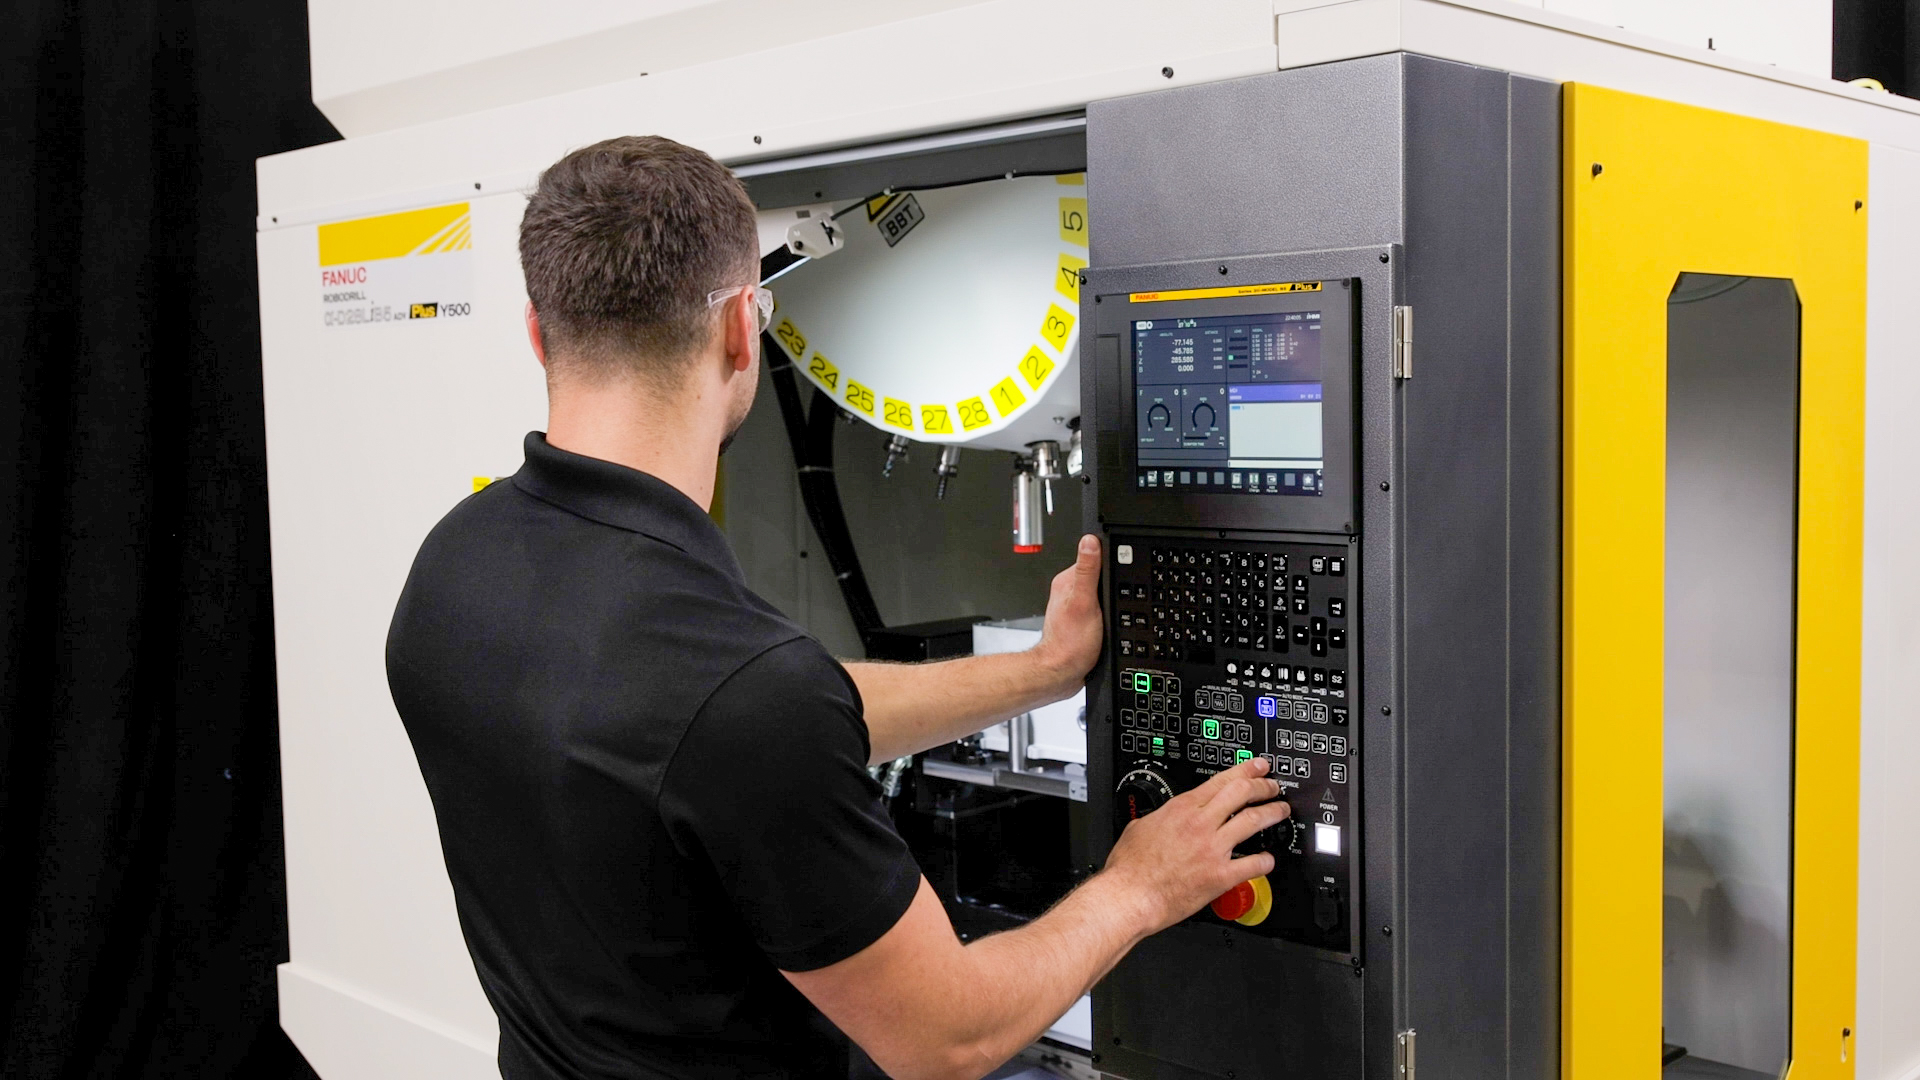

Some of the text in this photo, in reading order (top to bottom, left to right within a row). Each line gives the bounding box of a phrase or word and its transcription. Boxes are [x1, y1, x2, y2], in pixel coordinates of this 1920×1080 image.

[885, 204, 915, 238] BBT
[1063, 210, 1083, 232] 5
[322, 266, 367, 286] FANUC
[1061, 265, 1079, 288] 4
[1295, 283, 1313, 291] Plus
[323, 290, 367, 303] ROBODRILL
[411, 304, 437, 319] Plus
[440, 303, 471, 317] Y500
[1047, 315, 1068, 338] 3
[777, 321, 806, 357] 23
[1172, 338, 1194, 346] -77.145
[1026, 355, 1047, 381] 2
[809, 356, 839, 389] 24
[1000, 386, 1013, 405] 1
[1174, 388, 1179, 396] 0
[846, 384, 874, 413] 25
[884, 402, 913, 428] 26
[958, 400, 989, 428] 28
[921, 409, 948, 431] 27
[1189, 556, 1195, 564] G
[1241, 559, 1247, 567] 8
[1258, 560, 1264, 568] 9
[1158, 573, 1163, 581] X
[1241, 579, 1247, 587] 5
[1258, 580, 1264, 588] 6
[1190, 595, 1195, 603] K
[1206, 596, 1212, 604] R
[1242, 598, 1247, 606] 2
[1259, 599, 1264, 607] 3
[1158, 611, 1164, 619] M
[1174, 613, 1180, 621] S
[1190, 614, 1196, 622] T
[1207, 635, 1212, 643] B
[1314, 673, 1323, 681] S1
[1331, 675, 1342, 684] S2
[1278, 780, 1299, 788] OVERRIDE
[1319, 802, 1338, 811] POWER
[1323, 876, 1335, 884] USB
